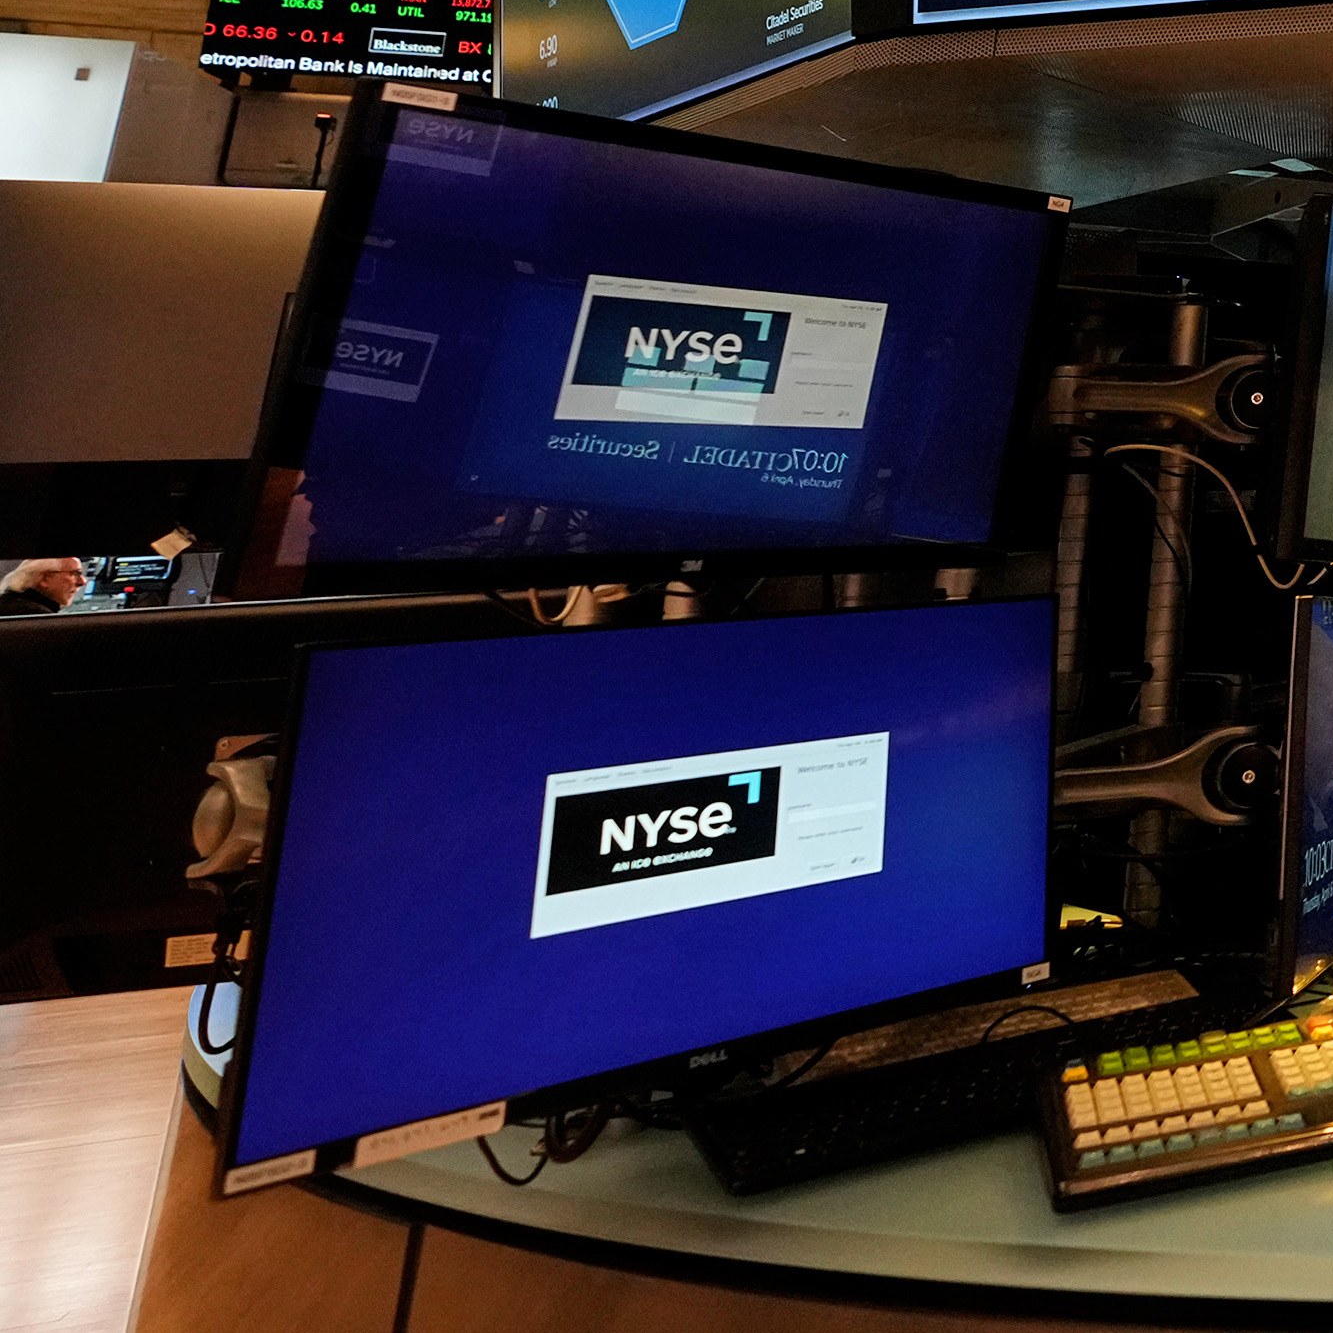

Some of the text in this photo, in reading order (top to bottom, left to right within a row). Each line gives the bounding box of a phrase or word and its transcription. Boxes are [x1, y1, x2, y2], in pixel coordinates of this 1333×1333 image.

[398, 6, 424, 17] UTIL
[223, 24, 277, 40] 66.36
[301, 30, 344, 44] 0.14
[373, 38, 441, 54] Blackstone
[299, 57, 480, 82] Bank Is Maintained at
